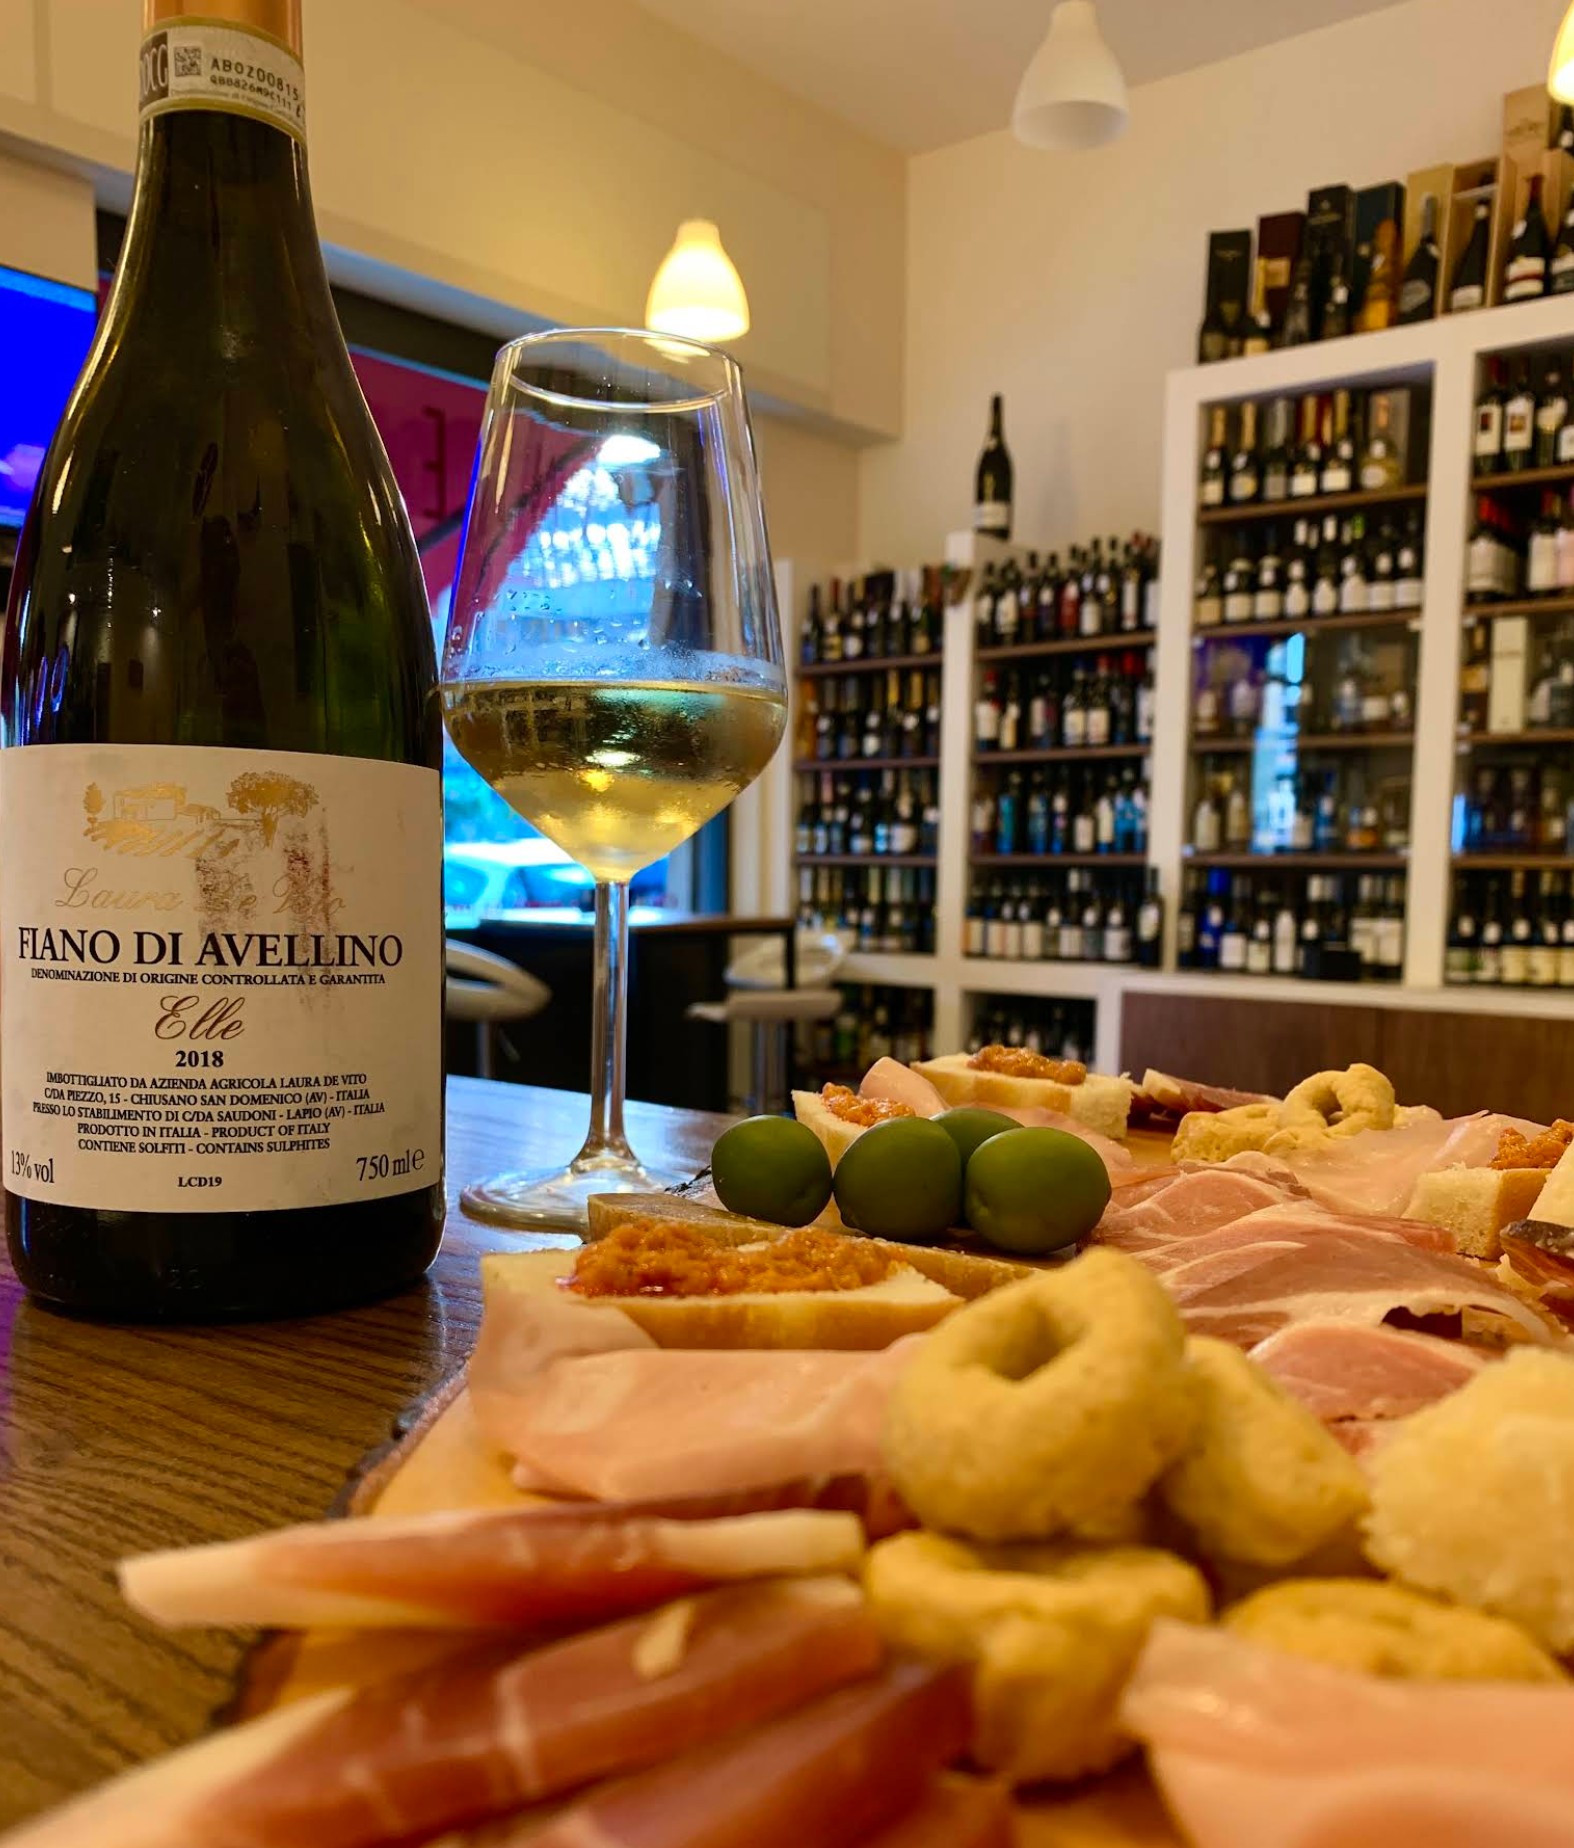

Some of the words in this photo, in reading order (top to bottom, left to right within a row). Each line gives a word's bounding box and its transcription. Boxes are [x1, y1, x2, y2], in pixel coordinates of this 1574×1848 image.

[195, 870, 257, 915] e
[272, 872, 346, 914] Vo
[18, 926, 121, 965] FIANO
[133, 931, 184, 966] DI
[194, 931, 403, 968] AVELLINO
[31, 967, 120, 983] DENOMINAZIONE
[123, 972, 137, 984] DI
[140, 973, 199, 985] ORIGINE
[201, 974, 305, 986] CONTROLLATA
[309, 975, 316, 985] E
[319, 974, 386, 985] GARANTITA
[154, 995, 246, 1040] Elle
[175, 1050, 224, 1068] 2018
[46, 1071, 127, 1088] IMBOTTIGLIATO
[130, 1077, 147, 1089] DA
[150, 1078, 207, 1090] AZIENDA
[210, 1078, 277, 1089] AGRICOLA
[280, 1076, 321, 1089] LAURA
[323, 1075, 339, 1086] DE
[341, 1073, 367, 1085] VITO
[44, 1087, 65, 1101] C/DA
[67, 1089, 107, 1105] PIEZZO,
[109, 1093, 121, 1104] 15
[130, 1093, 197, 1106] CHIUSANO
[200, 1095, 226, 1106] SAN
[229, 1093, 302, 1106] DOMENICO
[305, 1092, 327, 1105] (AV)
[336, 1088, 370, 1101] ITALIA
[33, 1101, 61, 1116] PRESSO
[62, 1105, 76, 1117] LO
[77, 1107, 162, 1122] STABILIMENTO
[165, 1111, 179, 1122] DI
[182, 1110, 214, 1123] C/DA
[217, 1110, 276, 1122] SAUDONI
[286, 1108, 322, 1120] LAPIO
[324, 1106, 345, 1119] (AV)
[354, 1102, 385, 1115] ITALIA
[77, 1122, 139, 1137] PRODOTTO
[142, 1126, 156, 1137] IN
[159, 1126, 201, 1138] ITALIA
[211, 1125, 275, 1138] PRODUCT
[278, 1124, 294, 1136] OF
[297, 1122, 331, 1135] ITALY
[78, 1138, 136, 1153] CONTIENE
[138, 1142, 186, 1154] SOLFITI
[196, 1142, 264, 1154] CONTAINS
[267, 1138, 331, 1153] SULPHITES
[11, 1150, 32, 1179] 13%
[34, 1158, 55, 1184] vol
[356, 1154, 389, 1181] 750
[177, 1176, 223, 1188] LCD19
